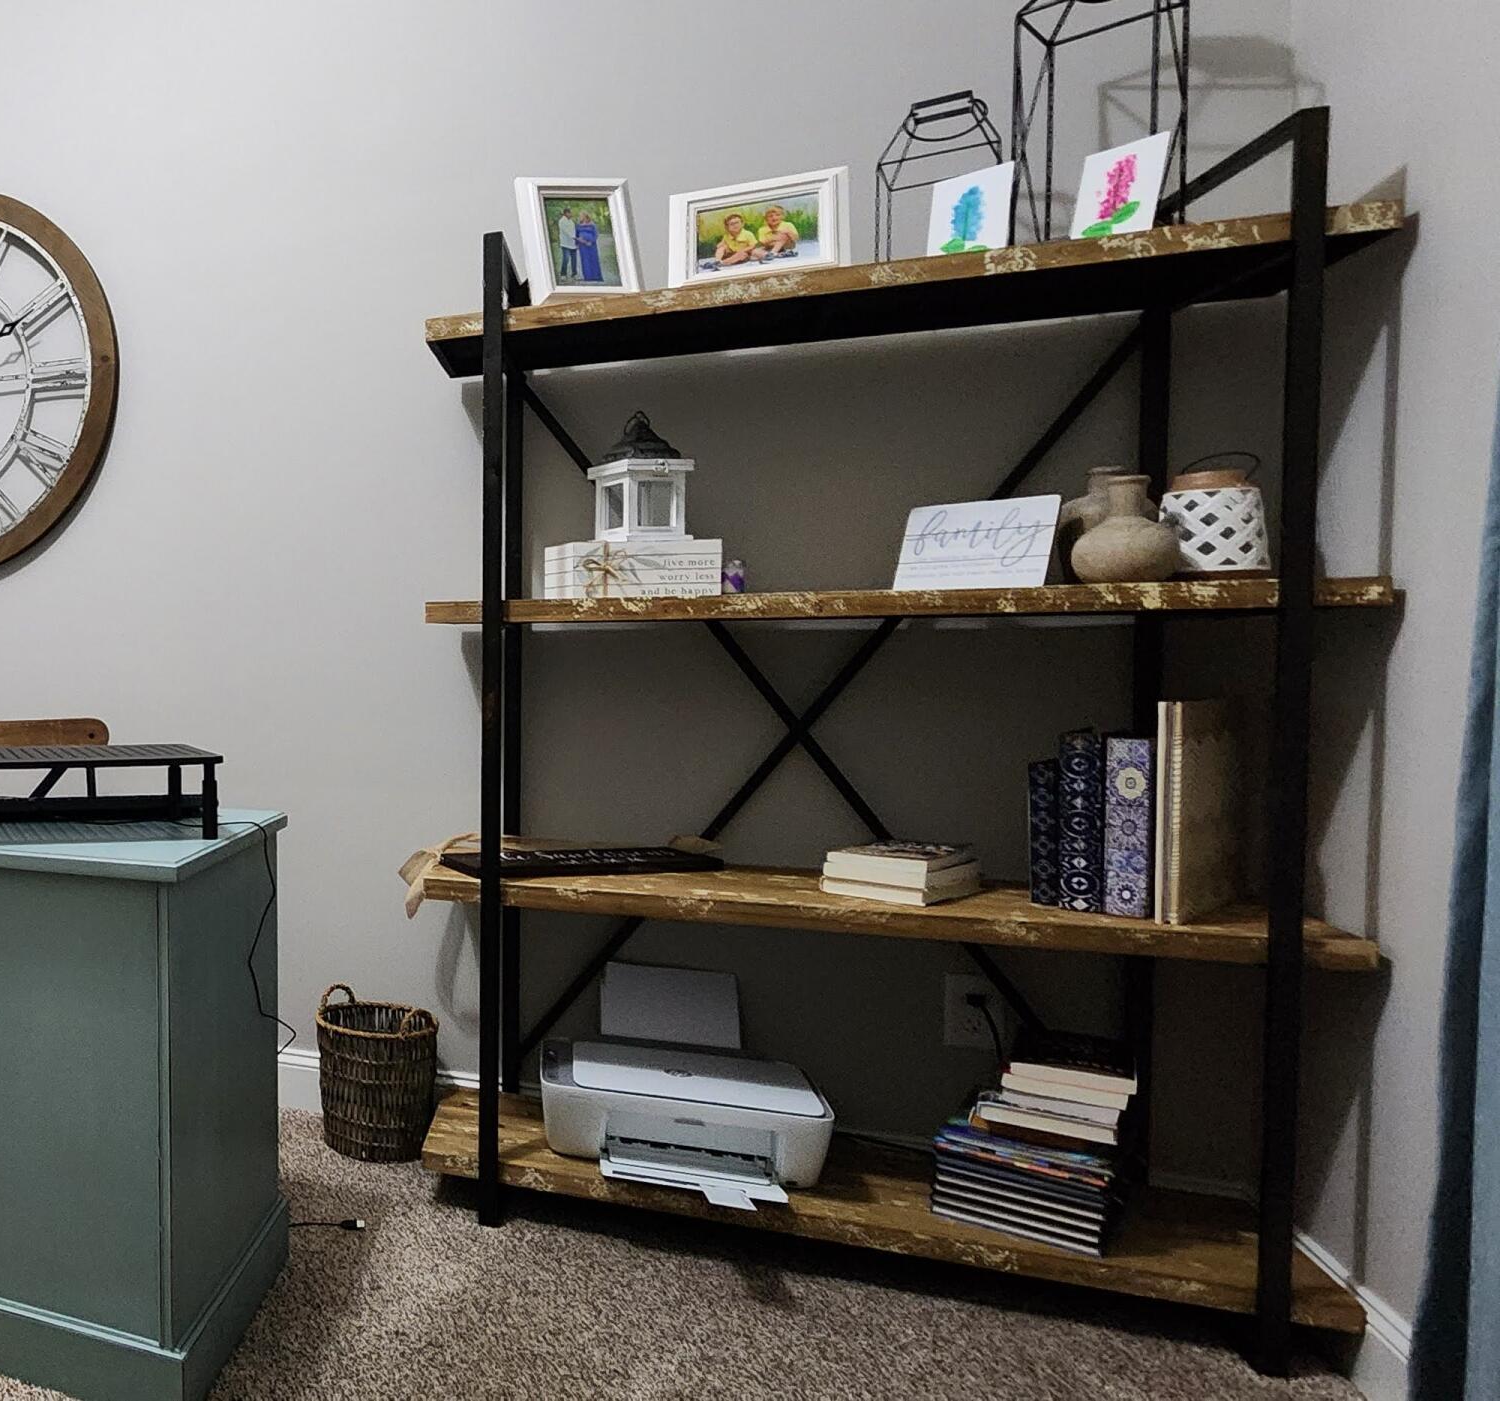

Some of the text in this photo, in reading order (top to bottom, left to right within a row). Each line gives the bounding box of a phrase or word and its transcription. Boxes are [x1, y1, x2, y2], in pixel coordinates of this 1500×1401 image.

[14, 276, 71, 330] II
[29, 356, 88, 391] III
[905, 507, 1051, 568] family
[663, 559, 716, 567] live more
[659, 572, 715, 582] worry less
[640, 587, 715, 597] and be happy
